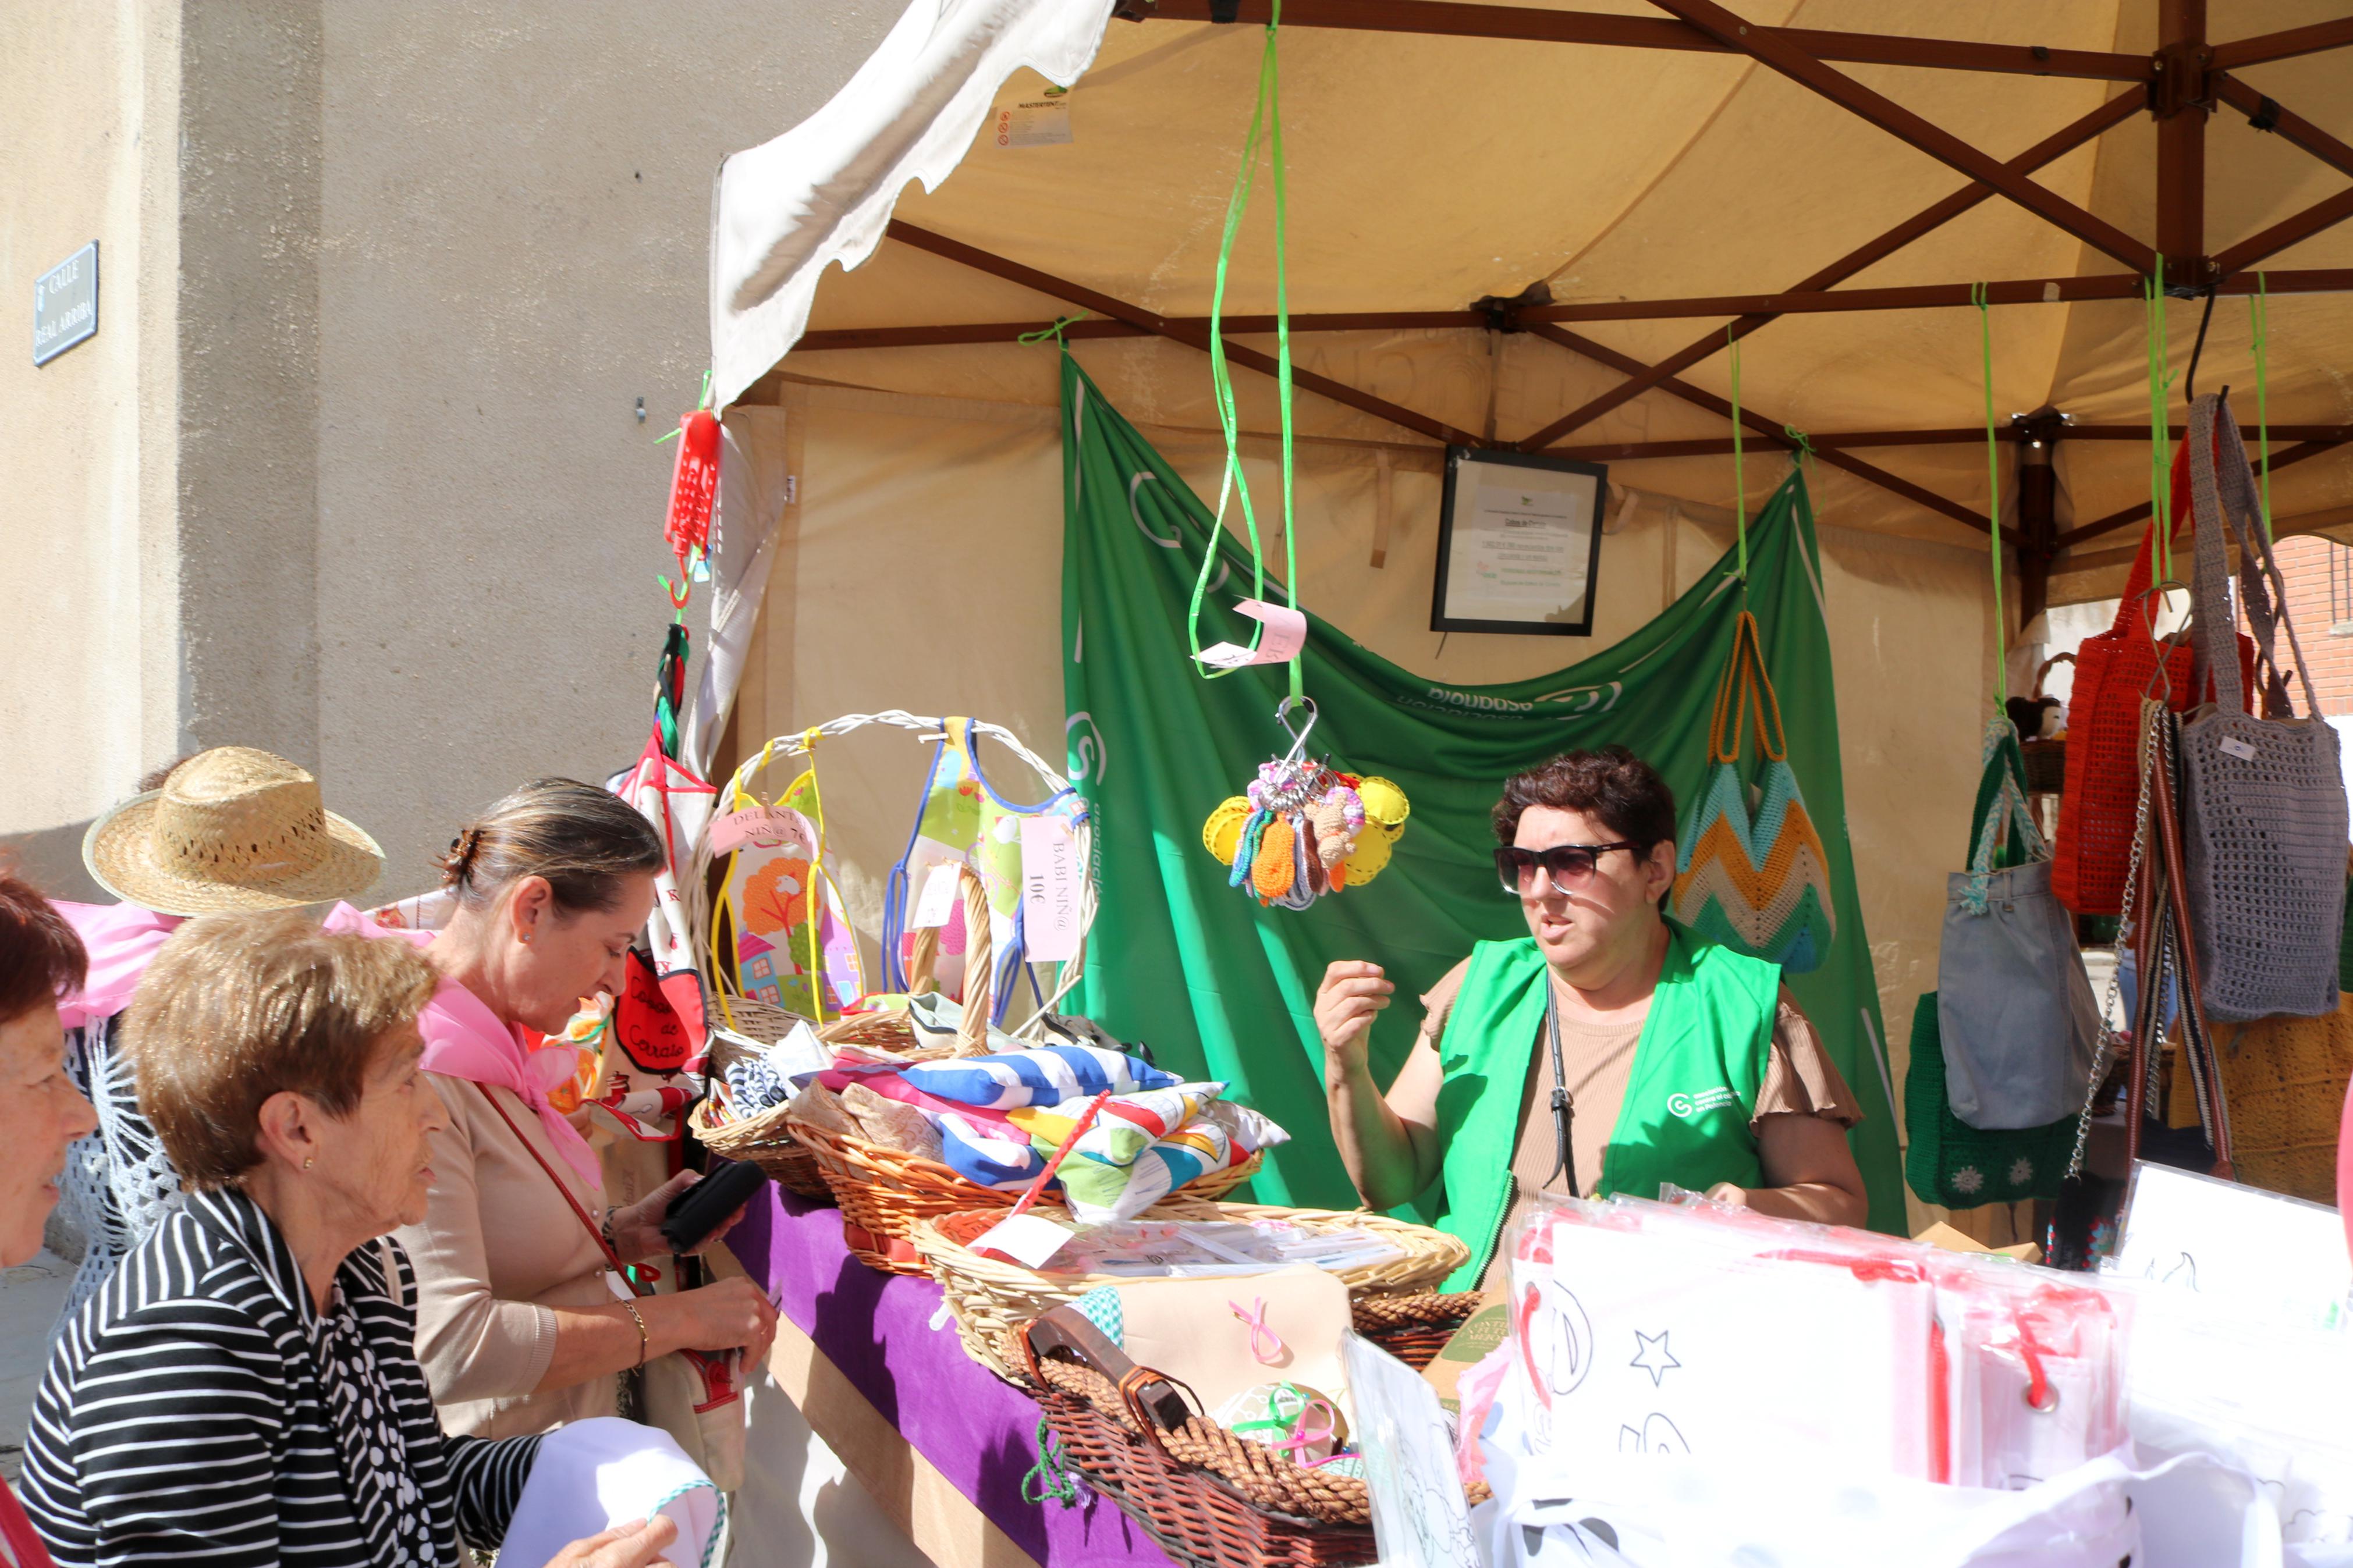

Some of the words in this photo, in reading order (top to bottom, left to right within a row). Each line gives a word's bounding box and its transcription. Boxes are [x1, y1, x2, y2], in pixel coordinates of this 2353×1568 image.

[49, 259, 80, 294] CALLE
[1052, 842, 1067, 881] BABI
[1030, 874, 1046, 904] 10€
